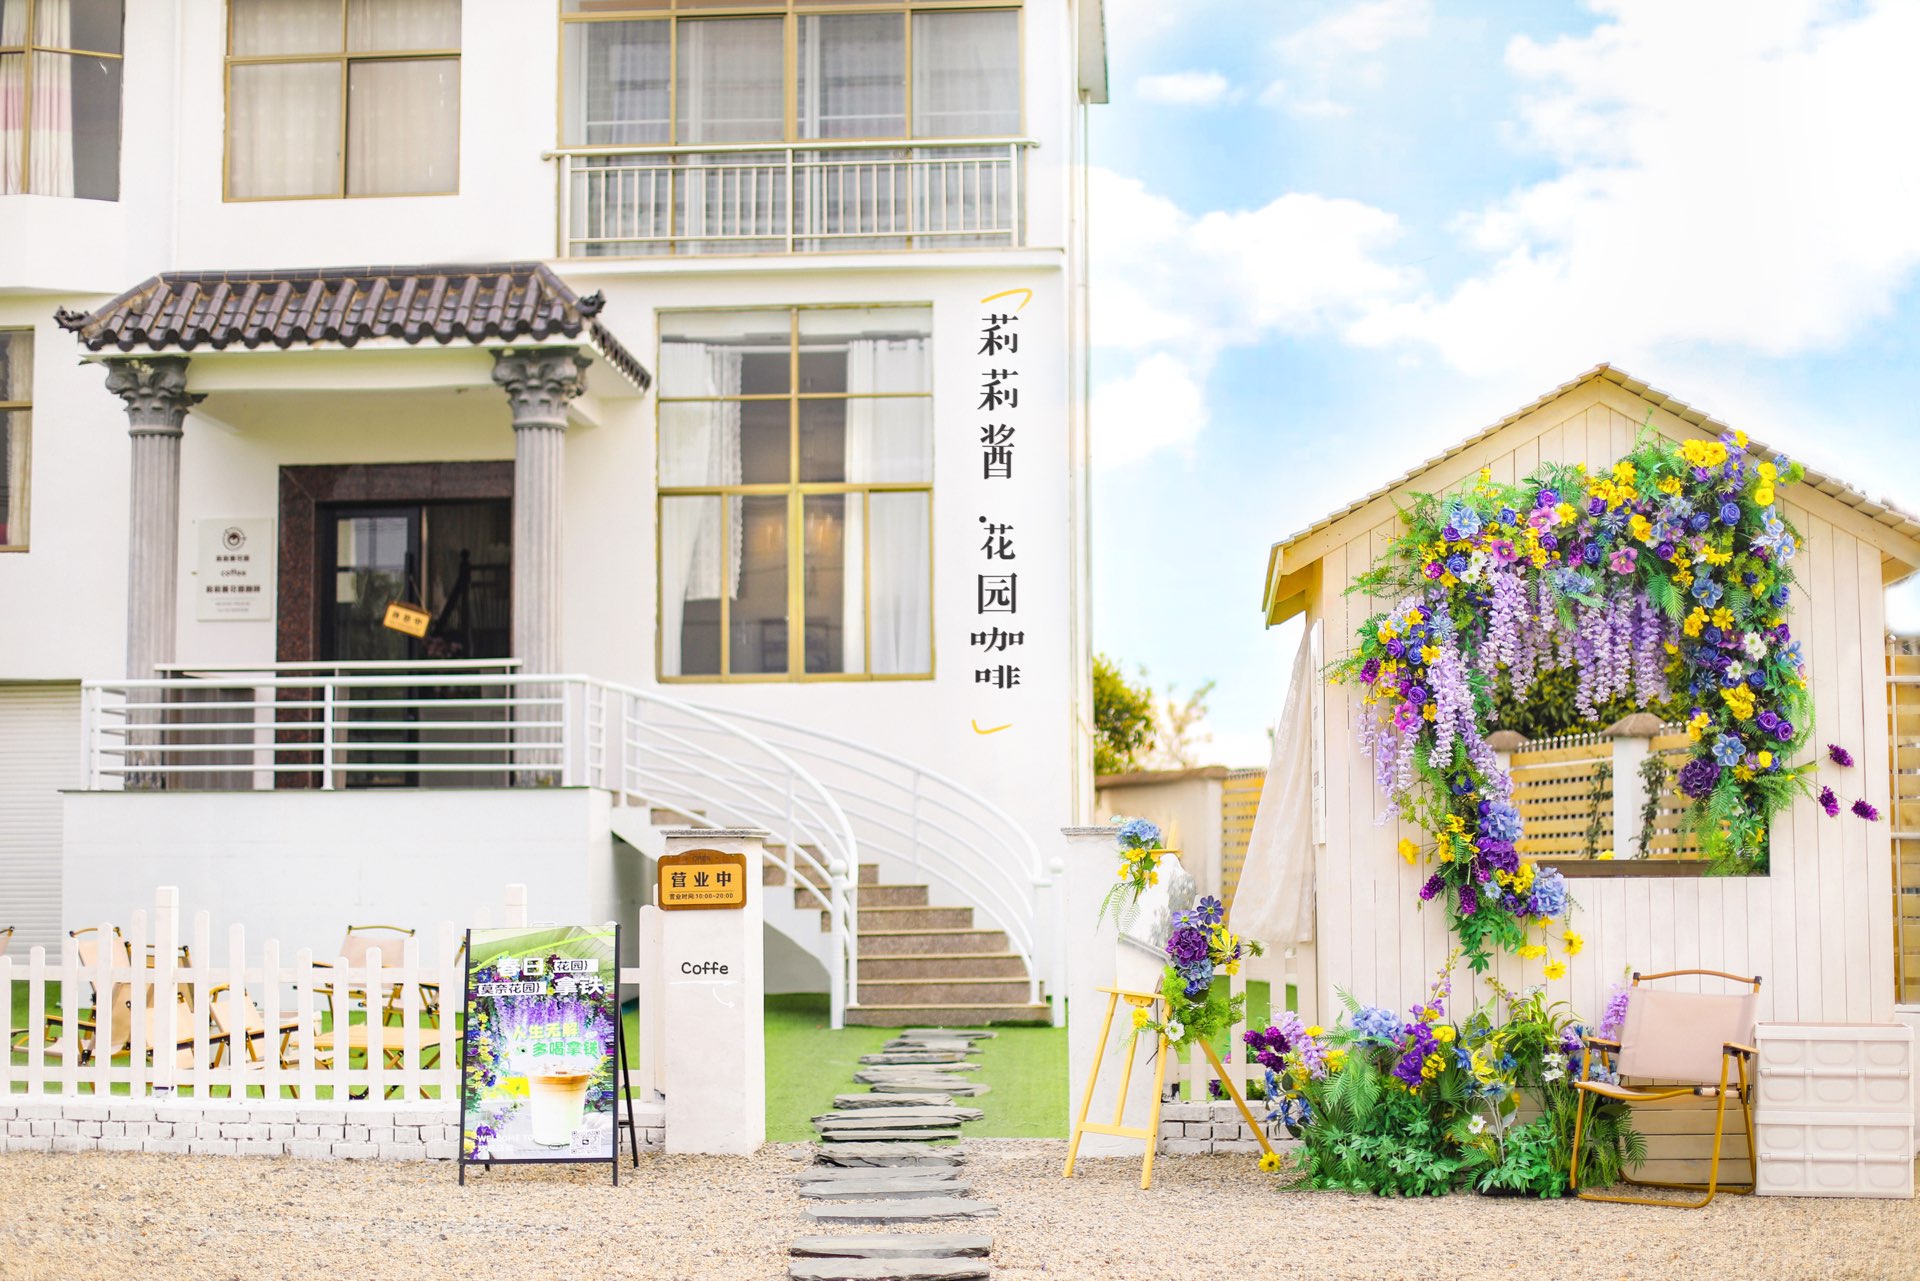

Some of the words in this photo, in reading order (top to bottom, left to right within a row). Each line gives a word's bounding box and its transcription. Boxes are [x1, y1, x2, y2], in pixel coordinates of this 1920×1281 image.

[671, 871, 732, 888] 营业中
[497, 957, 544, 976] 春日
[681, 962, 729, 975] Coffe
[555, 976, 604, 995] 拿铁
[532, 1041, 599, 1057] 多喝拿铁
